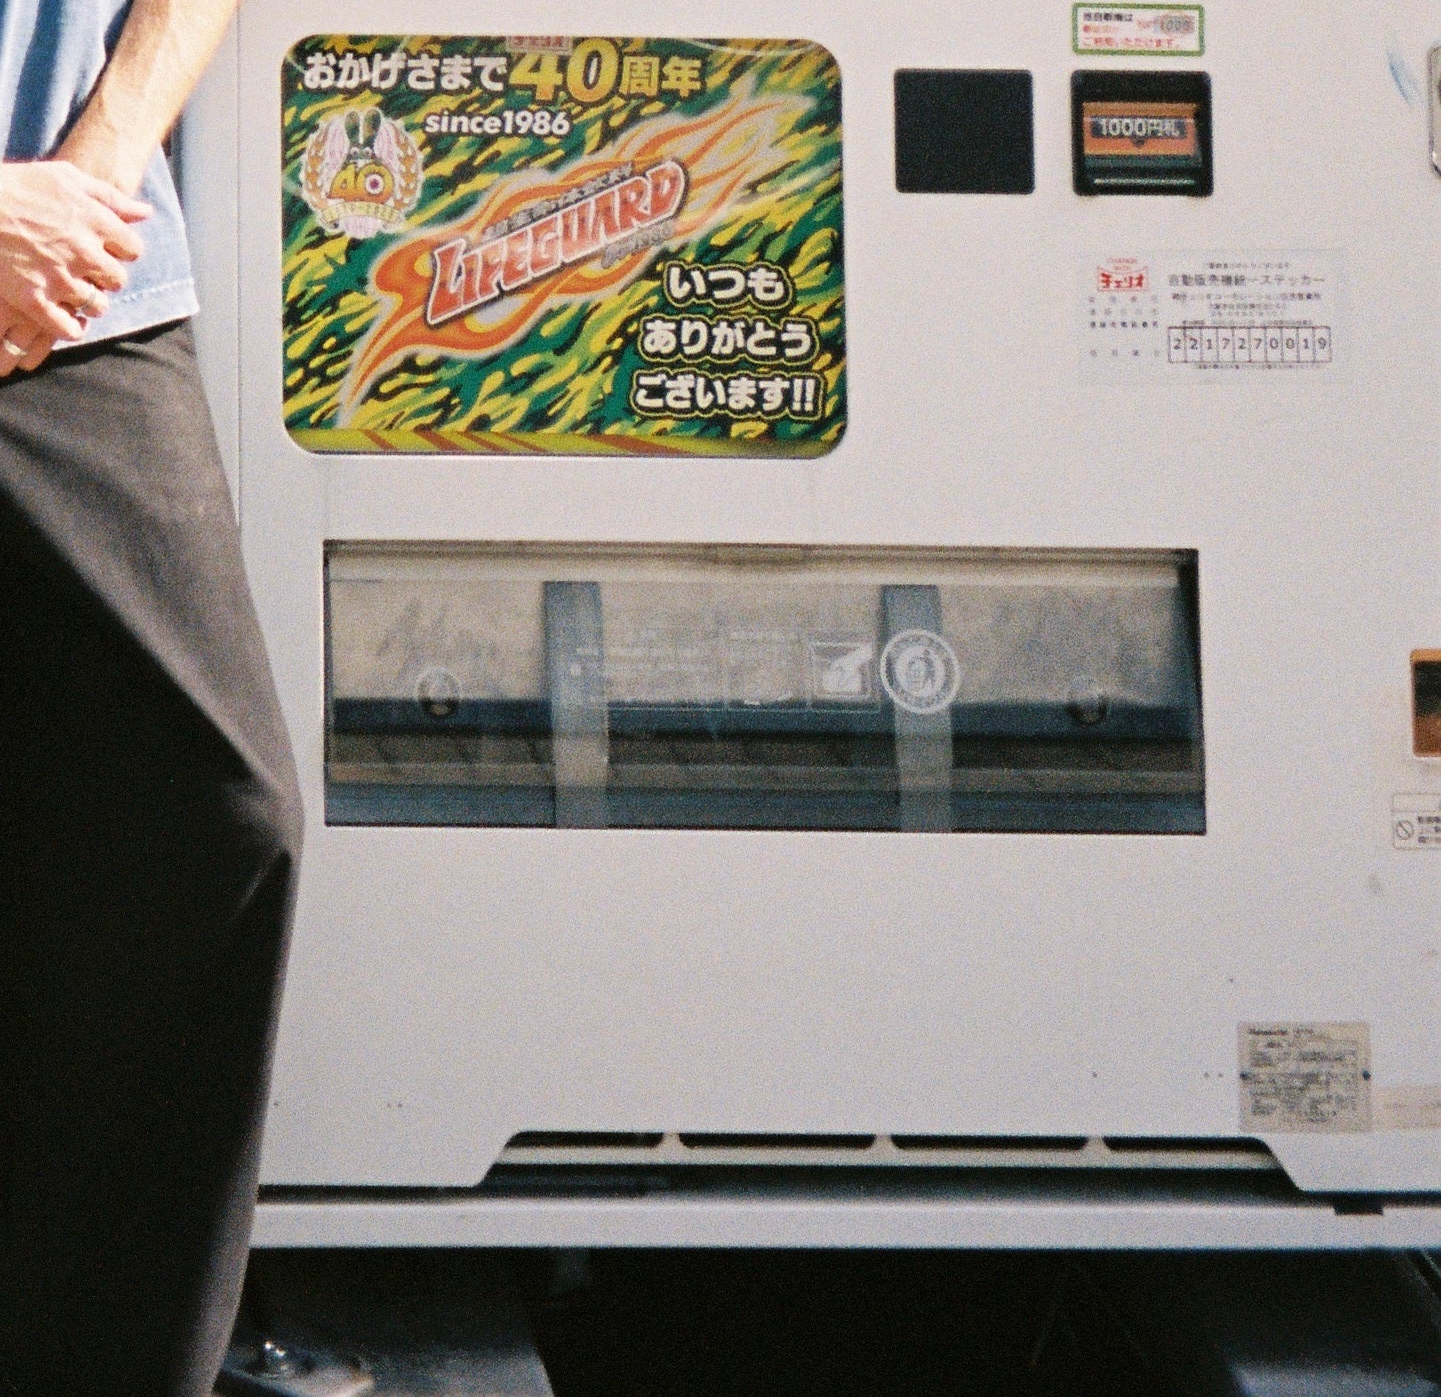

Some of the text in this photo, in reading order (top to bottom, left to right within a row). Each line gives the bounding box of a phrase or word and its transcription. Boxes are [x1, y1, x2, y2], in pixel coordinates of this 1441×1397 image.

[303, 38, 707, 104] おかげさまで40周年
[423, 110, 571, 136] since1986
[1100, 117, 1180, 137] 1000円札
[427, 161, 687, 325] LIFEGUARD
[670, 267, 788, 303] いつも
[1100, 272, 1145, 289] チェリオ
[643, 321, 818, 358] ありがとう
[635, 377, 817, 413] ございます!!
